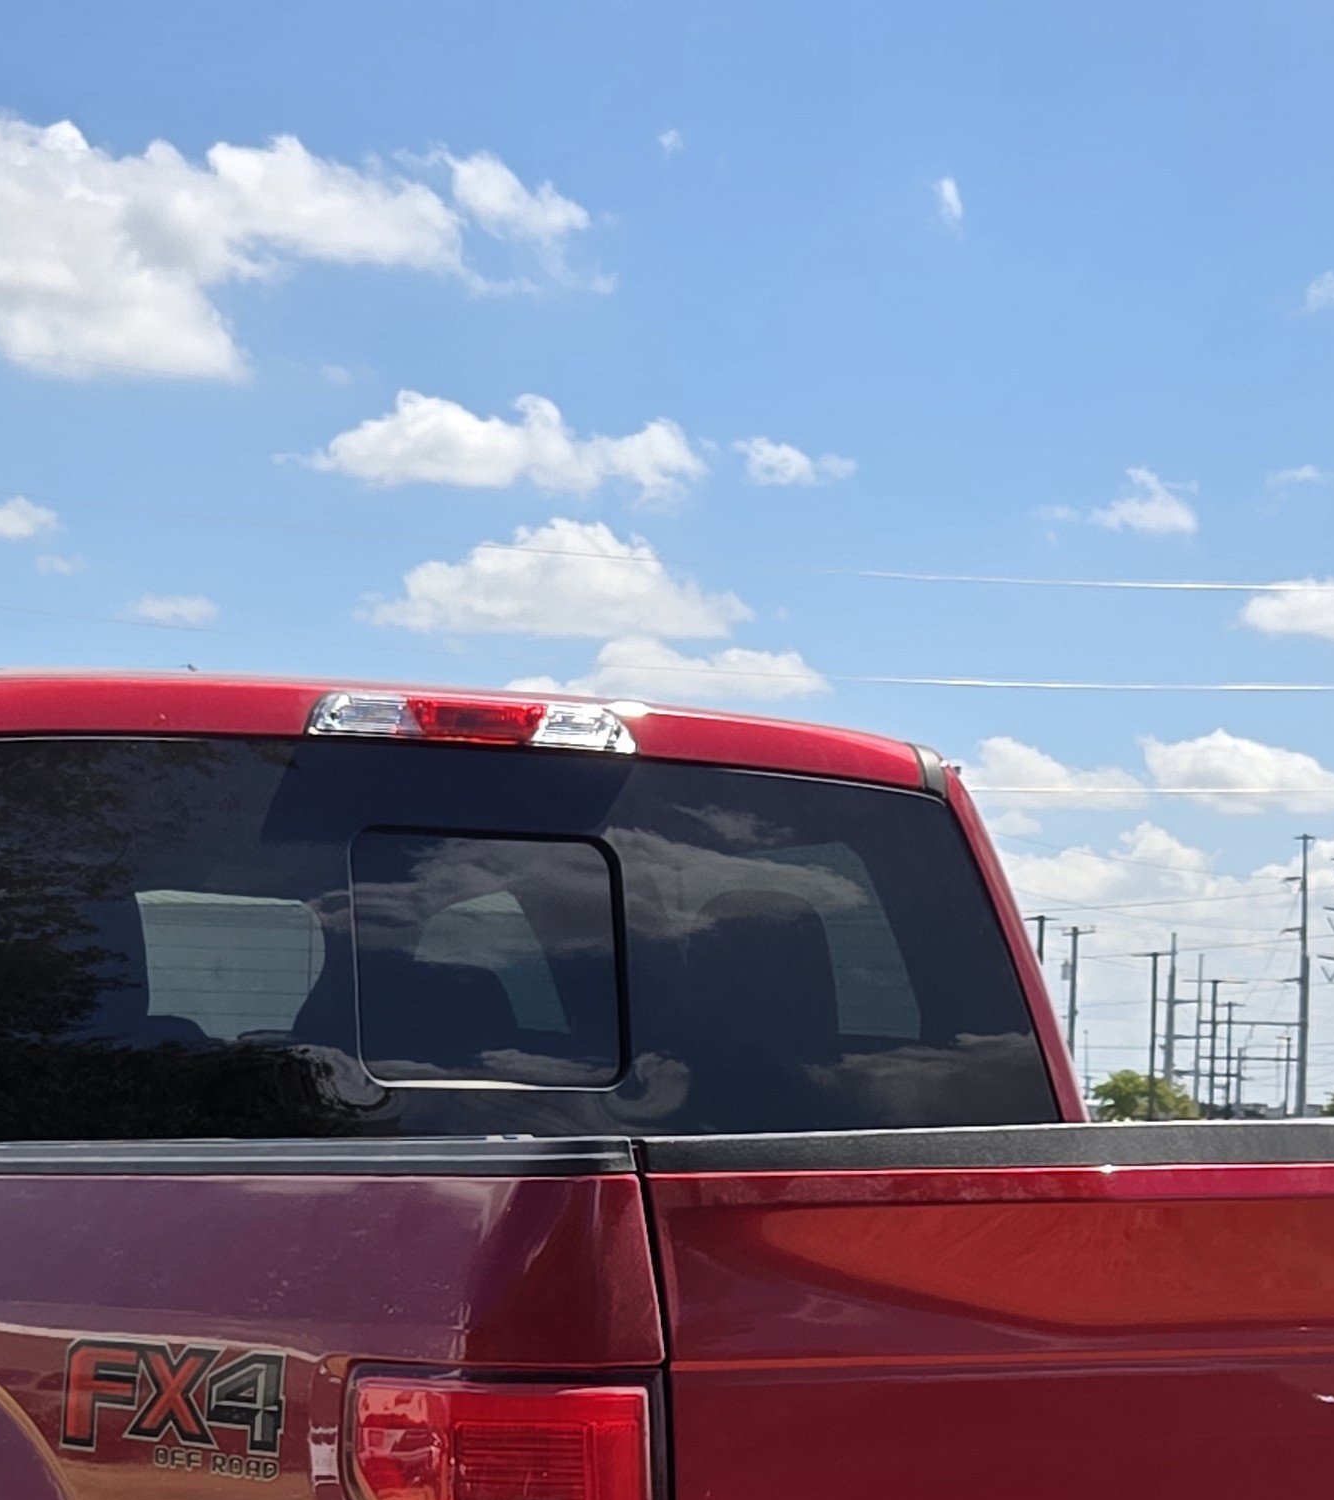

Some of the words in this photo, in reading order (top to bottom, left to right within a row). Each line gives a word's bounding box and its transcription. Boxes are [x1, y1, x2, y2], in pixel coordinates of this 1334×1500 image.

[60, 1335, 287, 1457] FX4
[153, 1446, 203, 1471] OFF
[209, 1453, 280, 1482] ROAD
